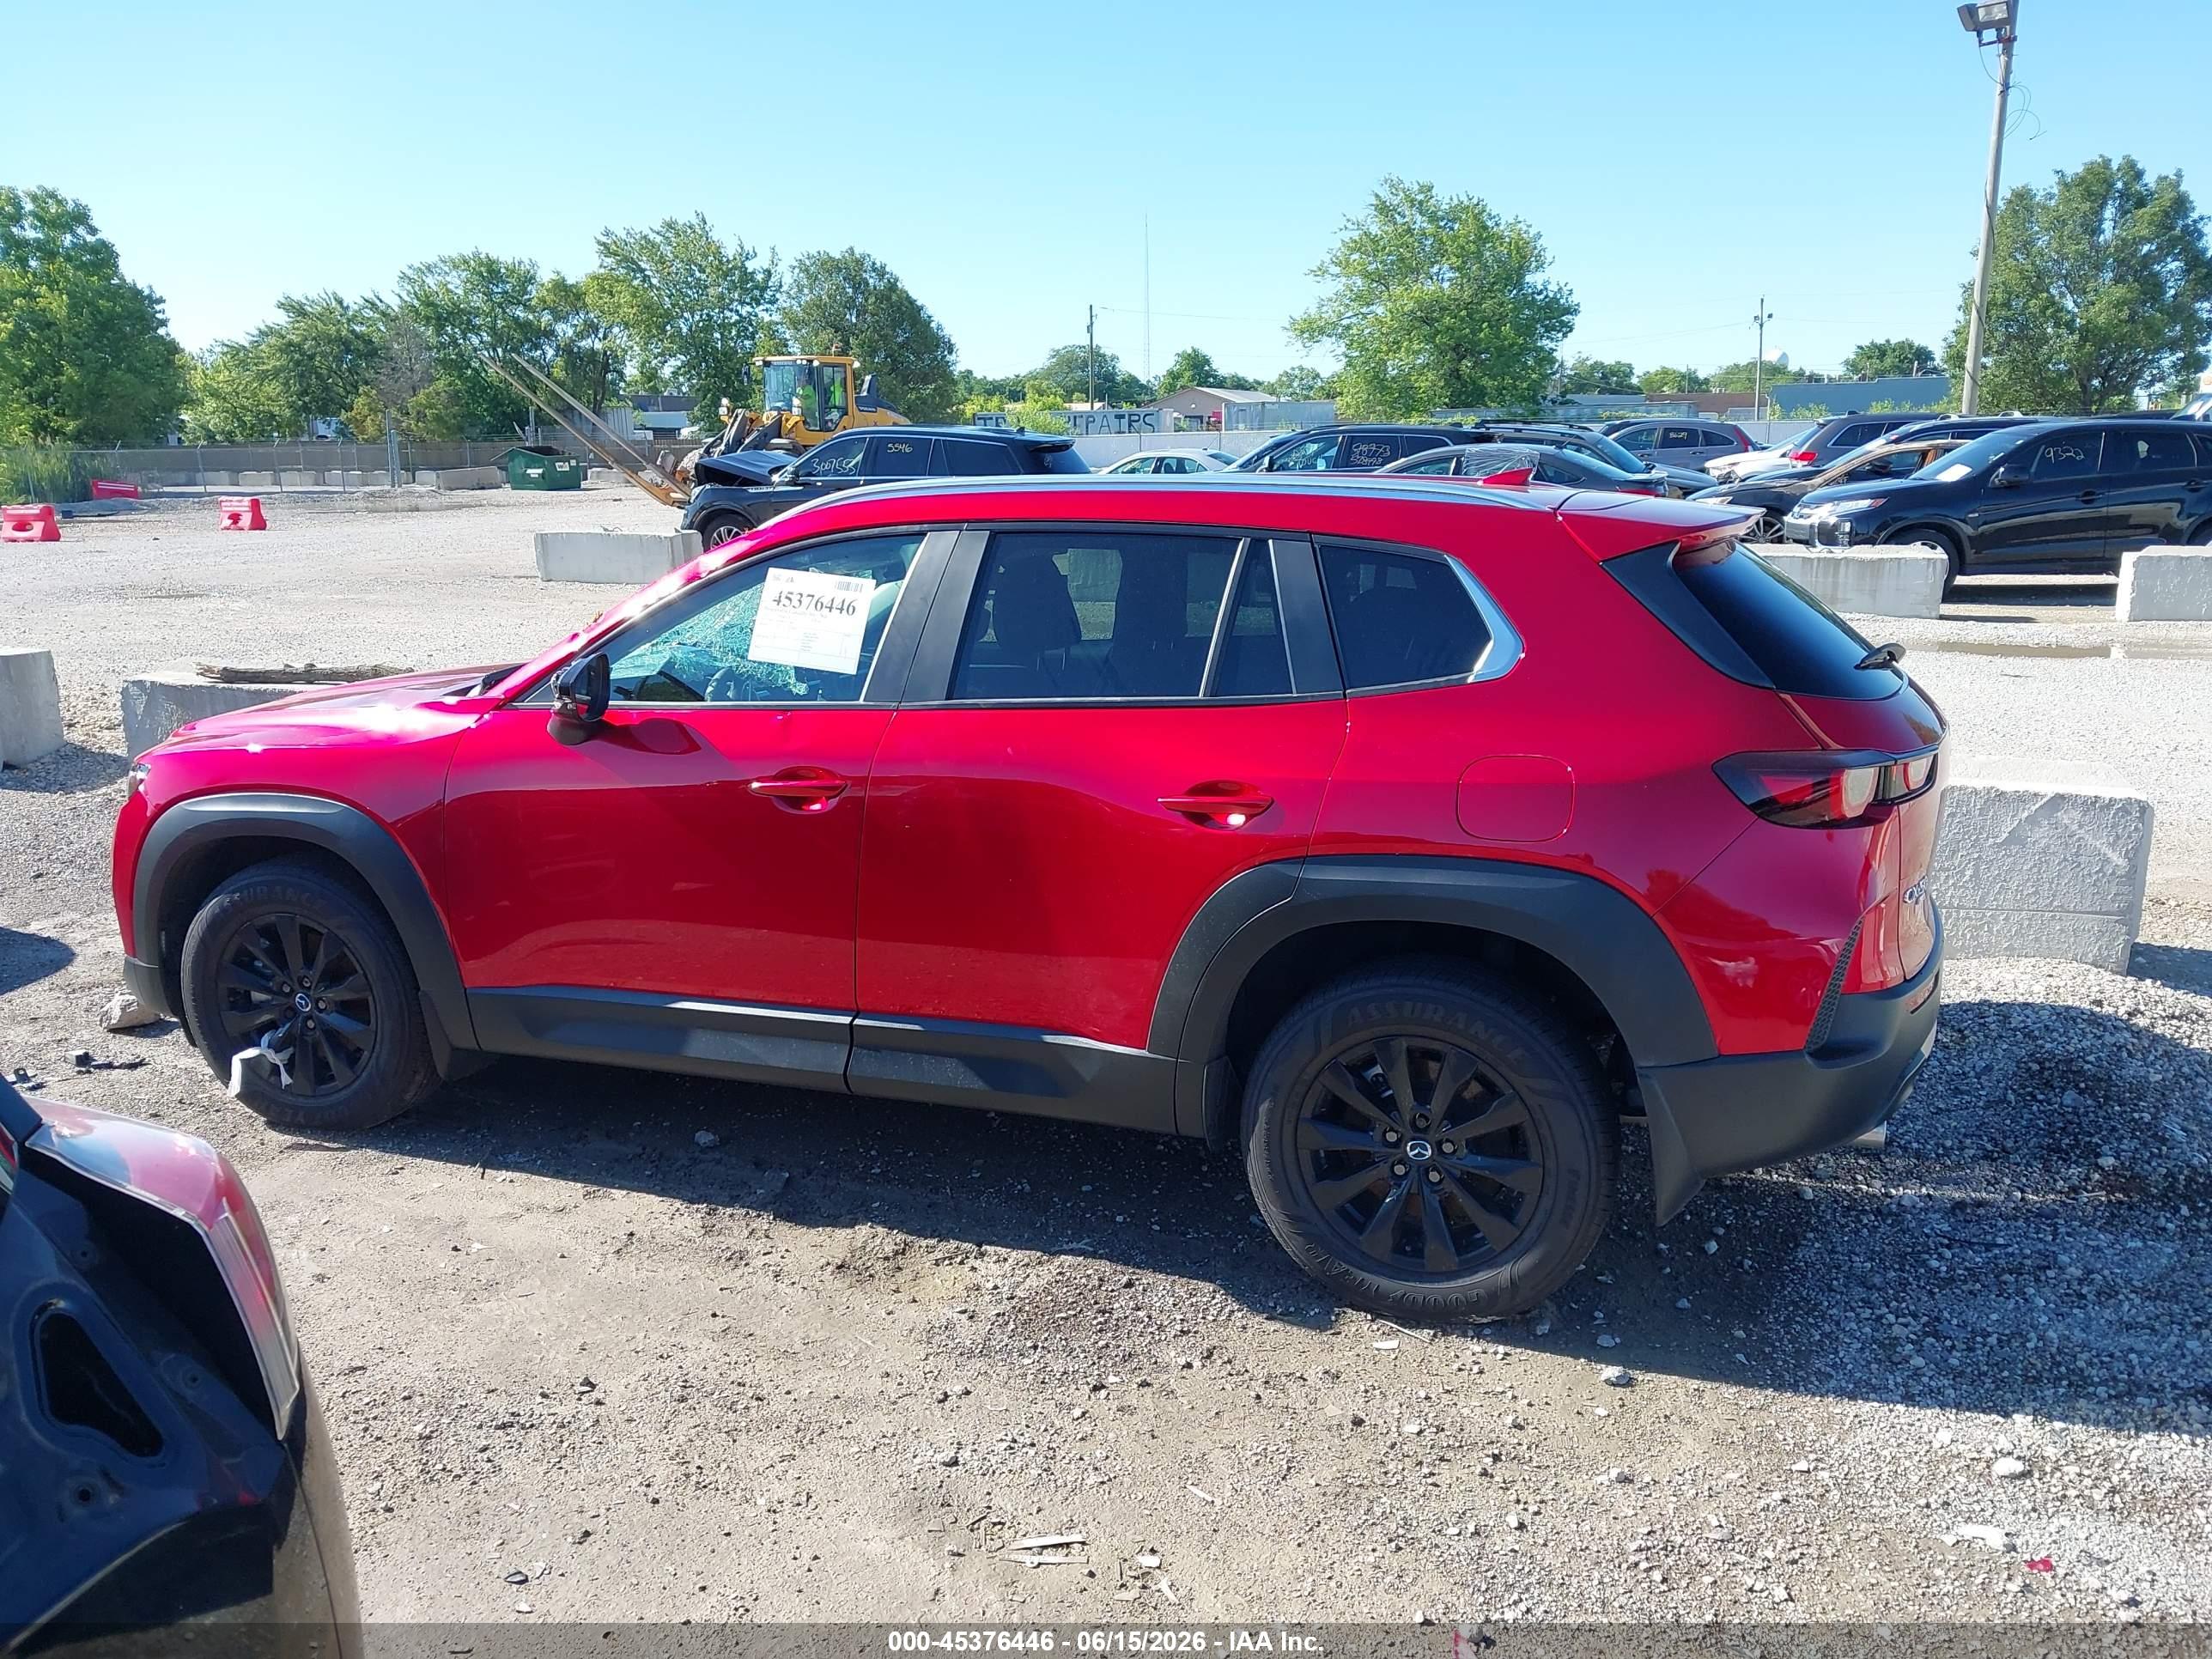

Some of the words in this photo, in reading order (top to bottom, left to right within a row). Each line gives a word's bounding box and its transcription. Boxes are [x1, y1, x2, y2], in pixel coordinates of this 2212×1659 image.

[886, 442, 914, 453] 5546
[2045, 446, 2085, 464] 9322
[772, 590, 858, 617] 45376446
